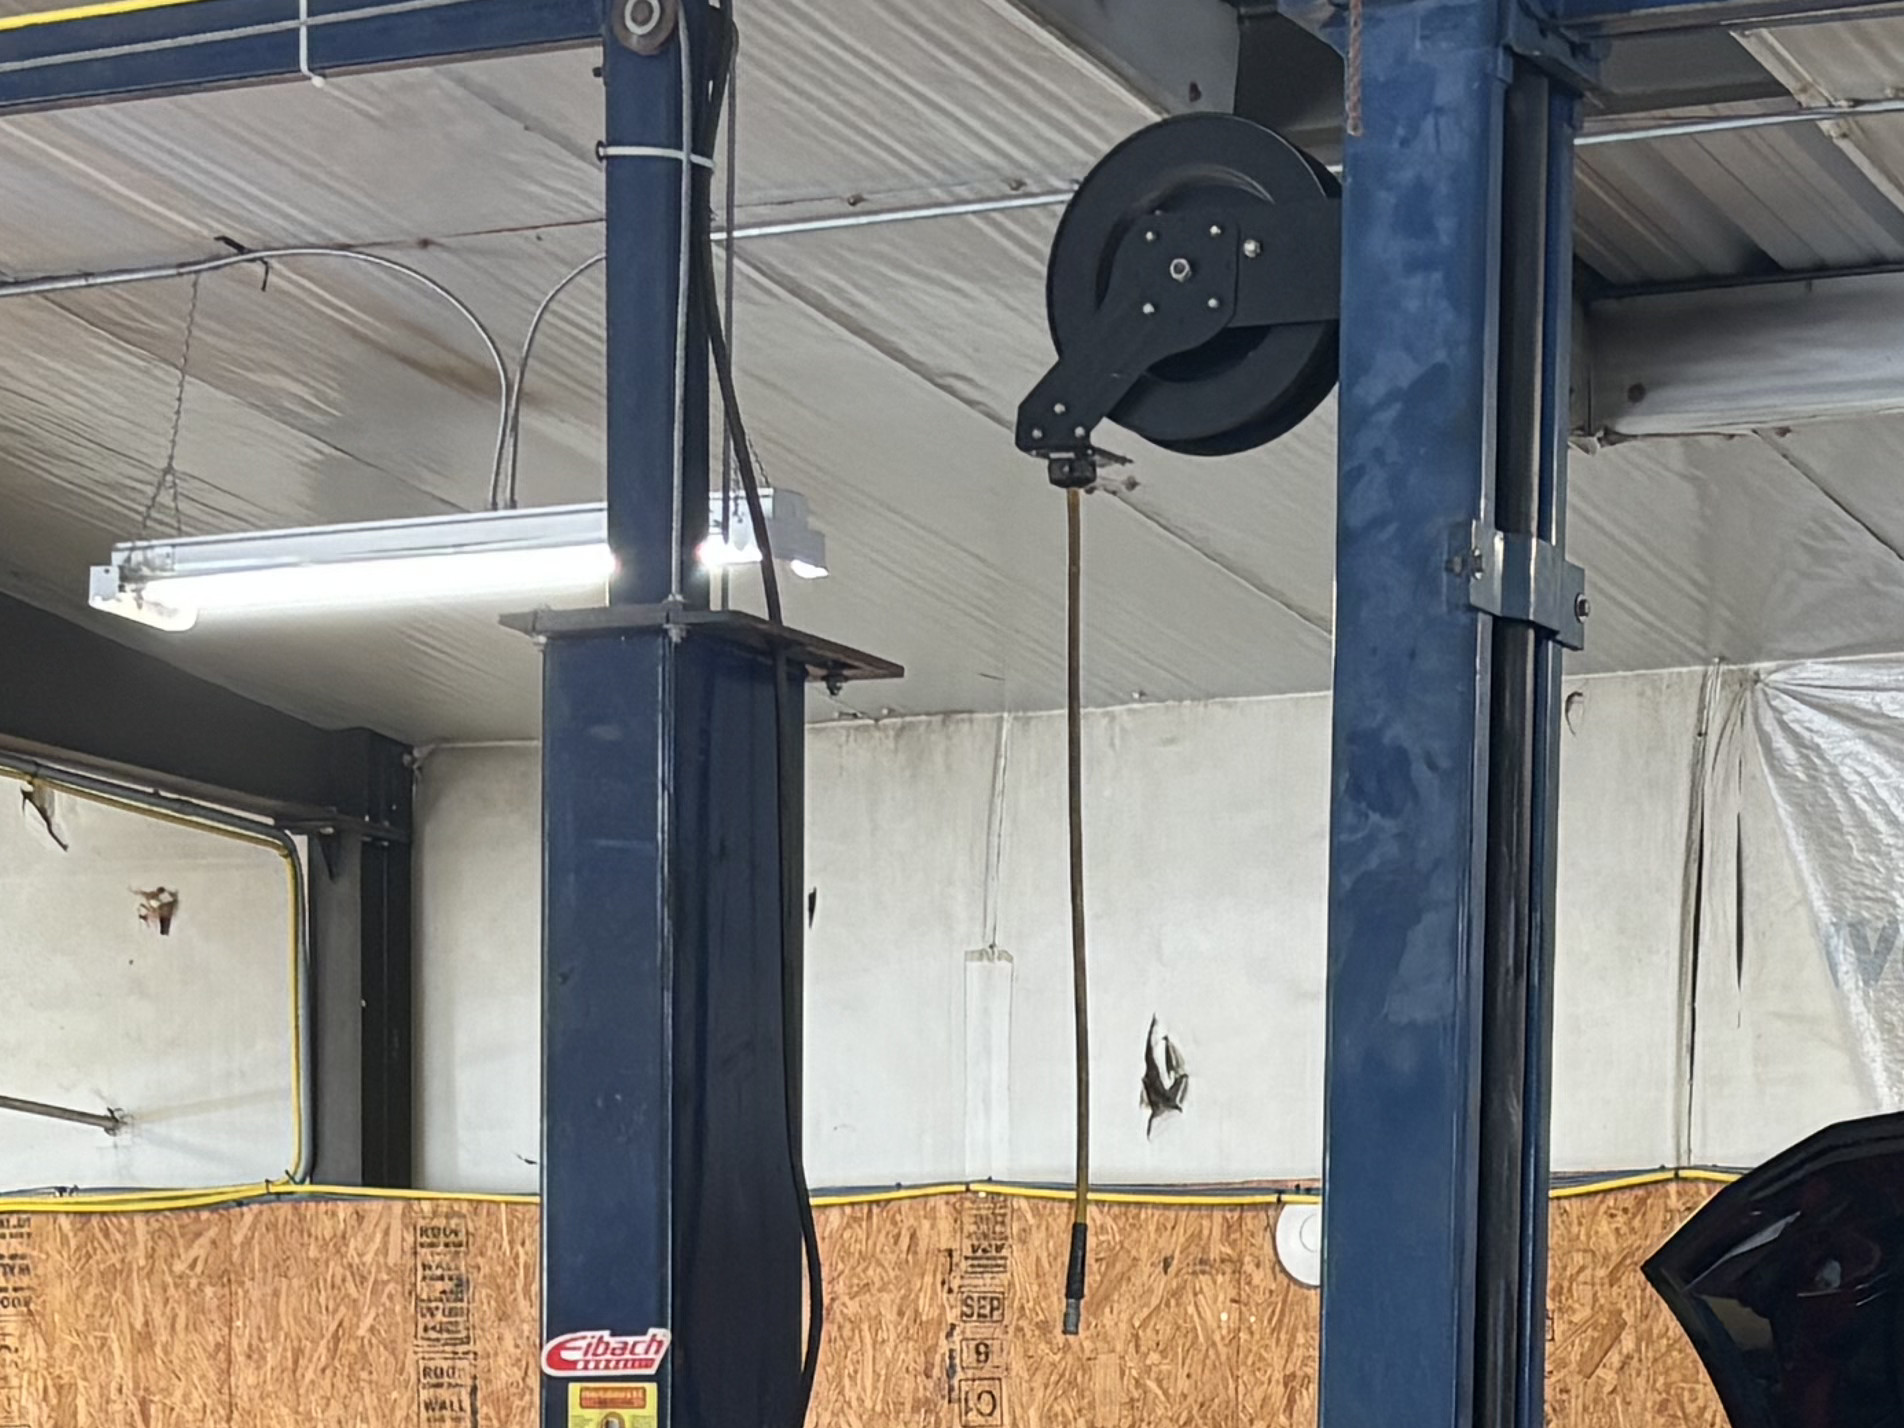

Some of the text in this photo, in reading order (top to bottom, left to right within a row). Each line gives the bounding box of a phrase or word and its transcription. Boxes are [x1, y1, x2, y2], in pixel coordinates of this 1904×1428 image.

[963, 1295, 1002, 1319] SEP
[546, 1333, 665, 1370] Eibach
[423, 1399, 466, 1413] WALL
